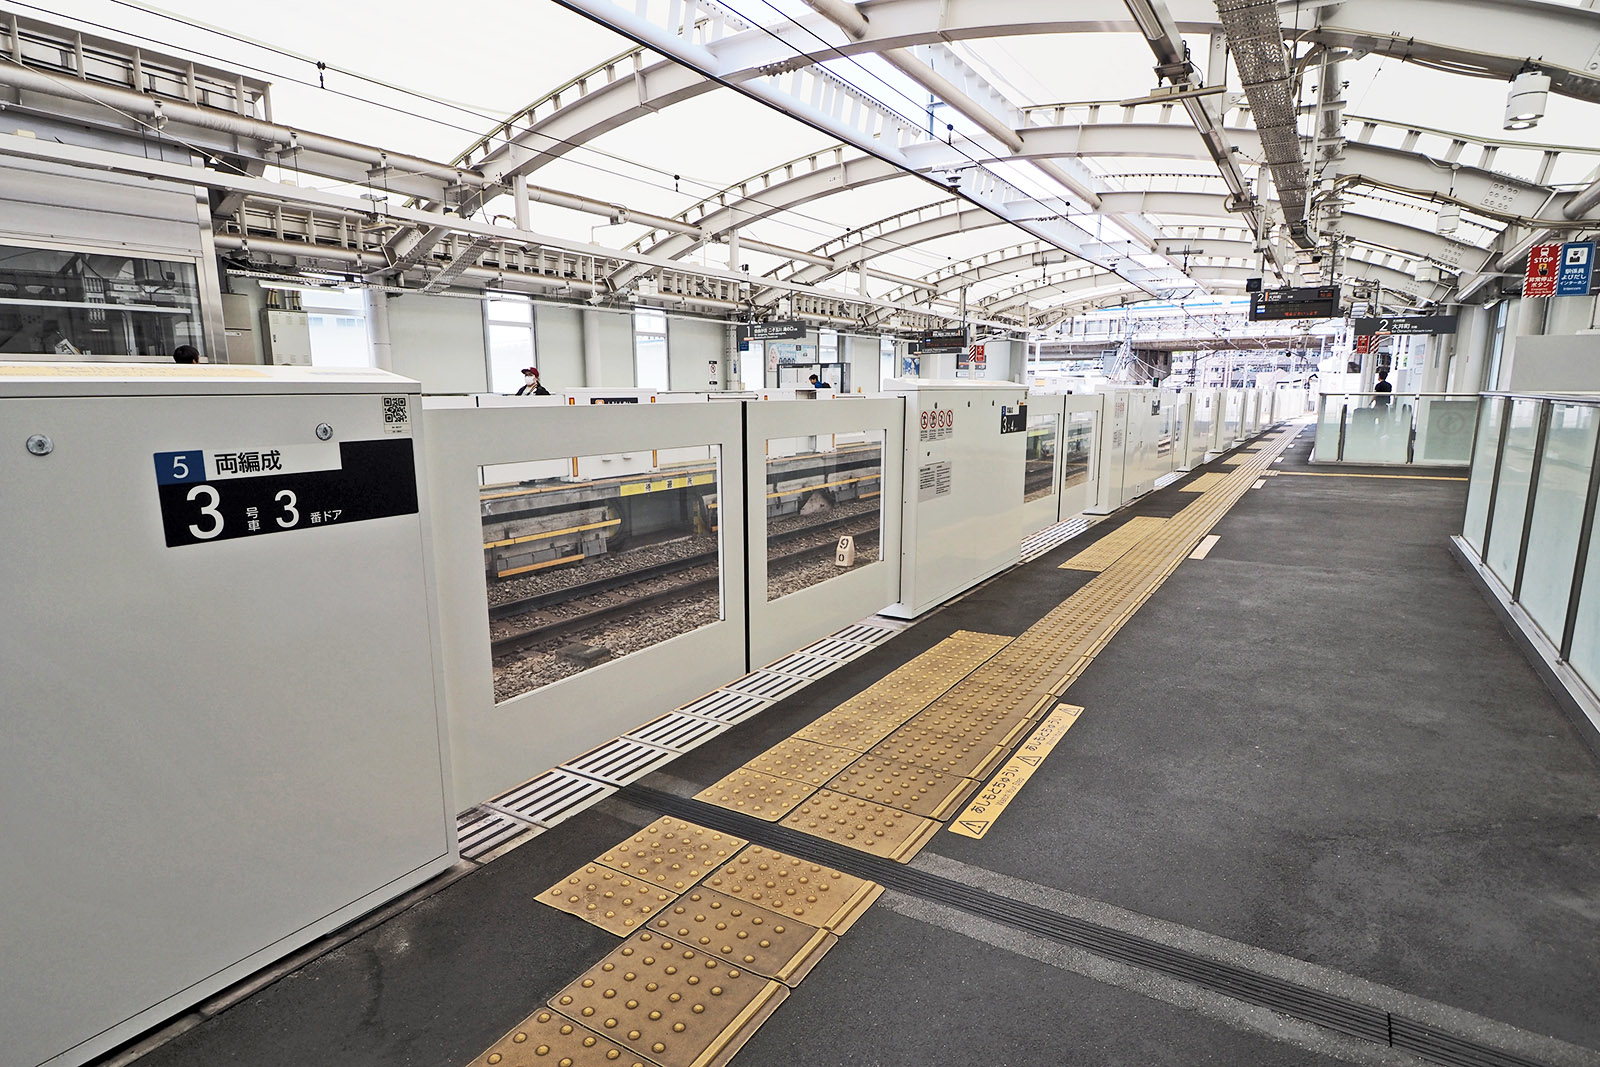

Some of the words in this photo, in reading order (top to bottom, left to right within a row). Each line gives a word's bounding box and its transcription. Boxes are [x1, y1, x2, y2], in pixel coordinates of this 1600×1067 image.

[1257, 294, 1264, 302] 2
[746, 326, 750, 337] 1
[1379, 319, 1388, 331] 2
[1002, 416, 1008, 432] 3
[172, 456, 190, 479] 5
[214, 450, 282, 475] 両編成
[186, 484, 224, 540] 3
[246, 506, 261, 532] 号車
[274, 490, 300, 528] 3
[310, 508, 342, 524] 番ドア
[839, 538, 849, 550] 9
[1025, 715, 1062, 752] あしもとちゅうい
[970, 766, 1020, 814] あしもとちゅうい
